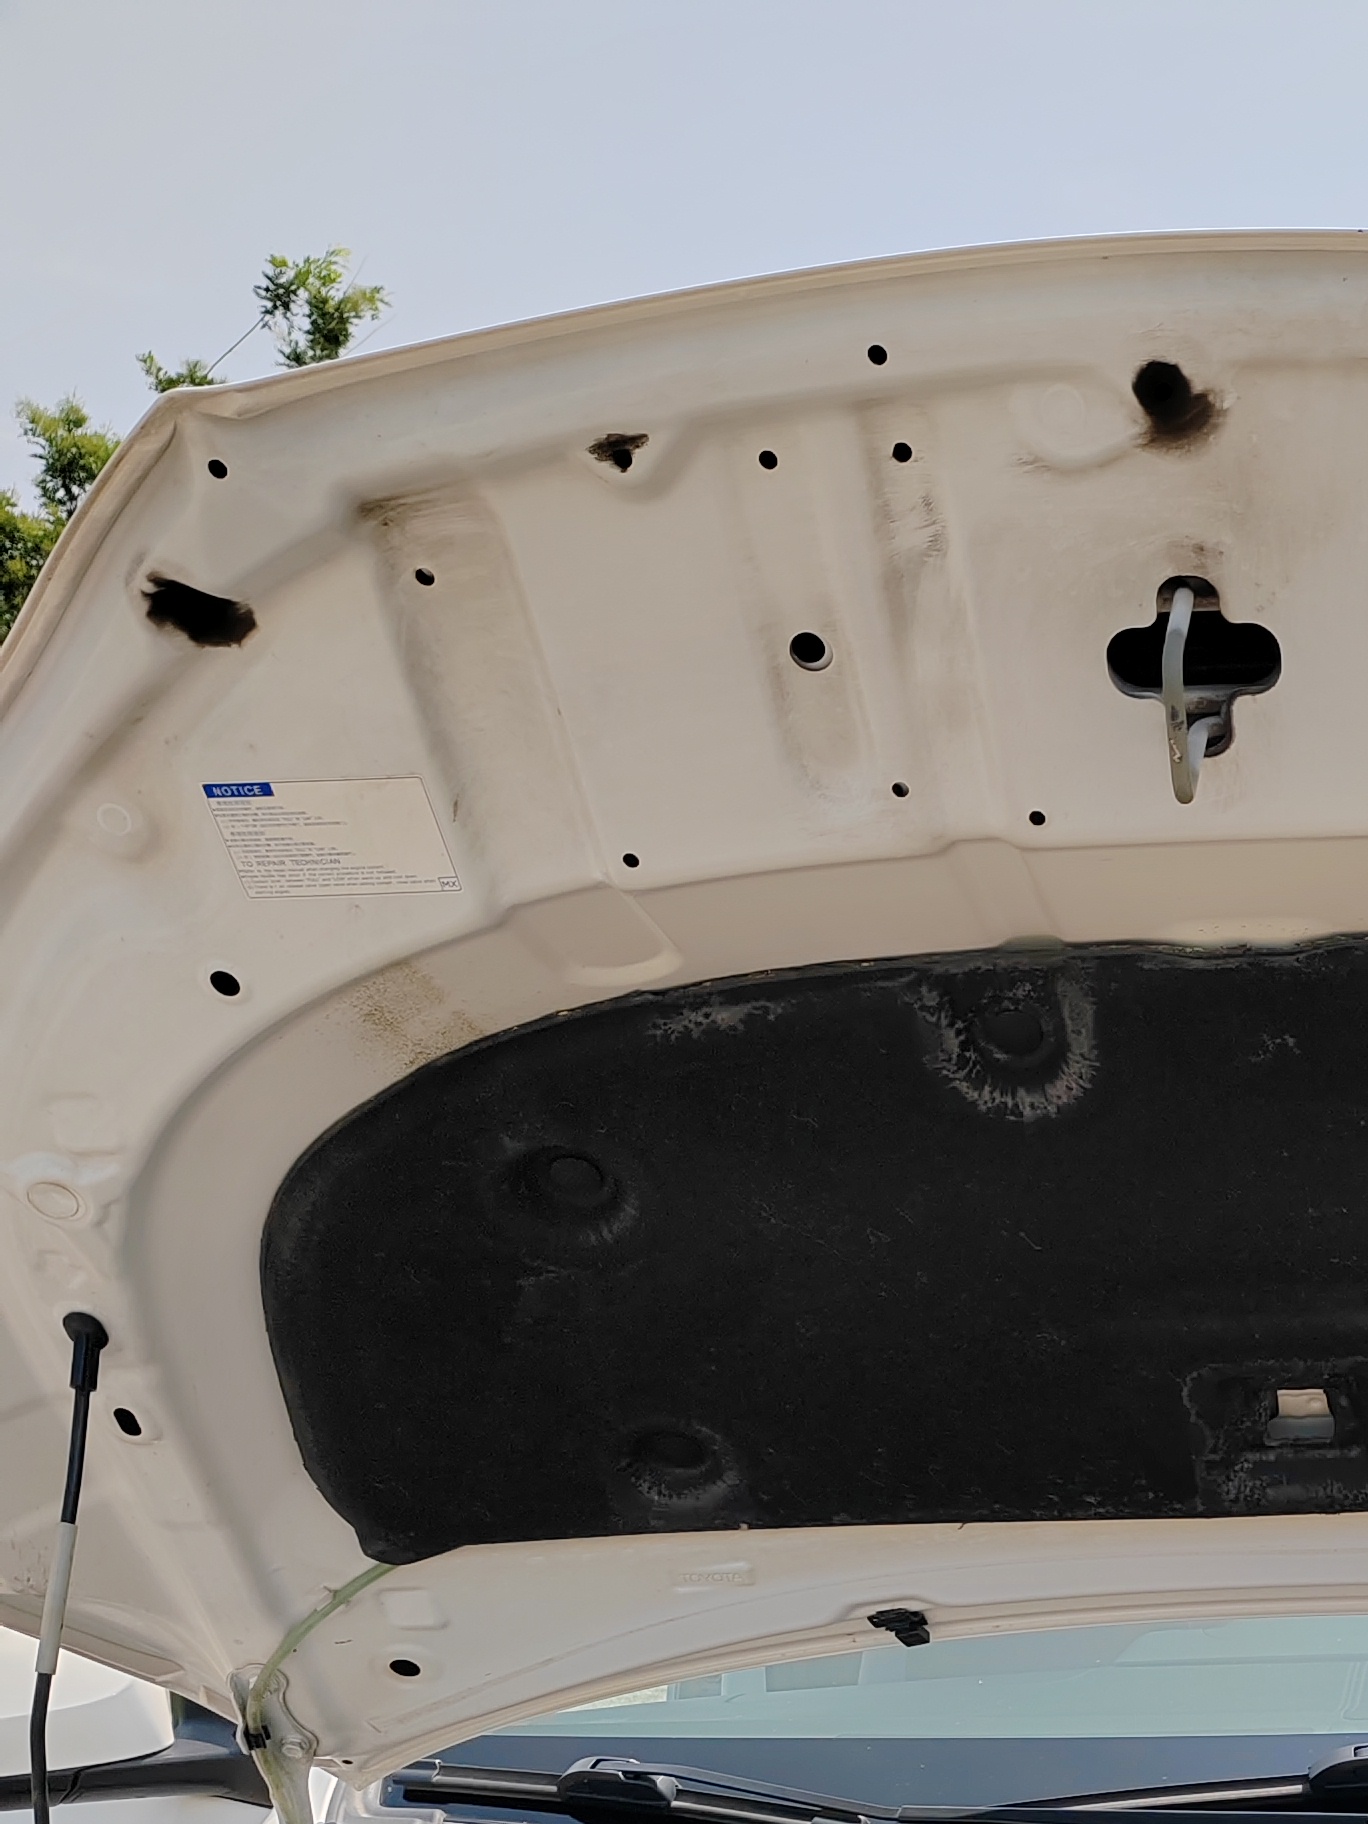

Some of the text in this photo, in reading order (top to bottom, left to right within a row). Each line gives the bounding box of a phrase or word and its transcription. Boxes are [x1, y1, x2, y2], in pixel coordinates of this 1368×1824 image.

[212, 785, 263, 797] NOTICE
[240, 858, 341, 868] TO REPAIR TECHNICIAN
[441, 880, 458, 888] MX
[680, 1572, 744, 1582] TOYOTA
